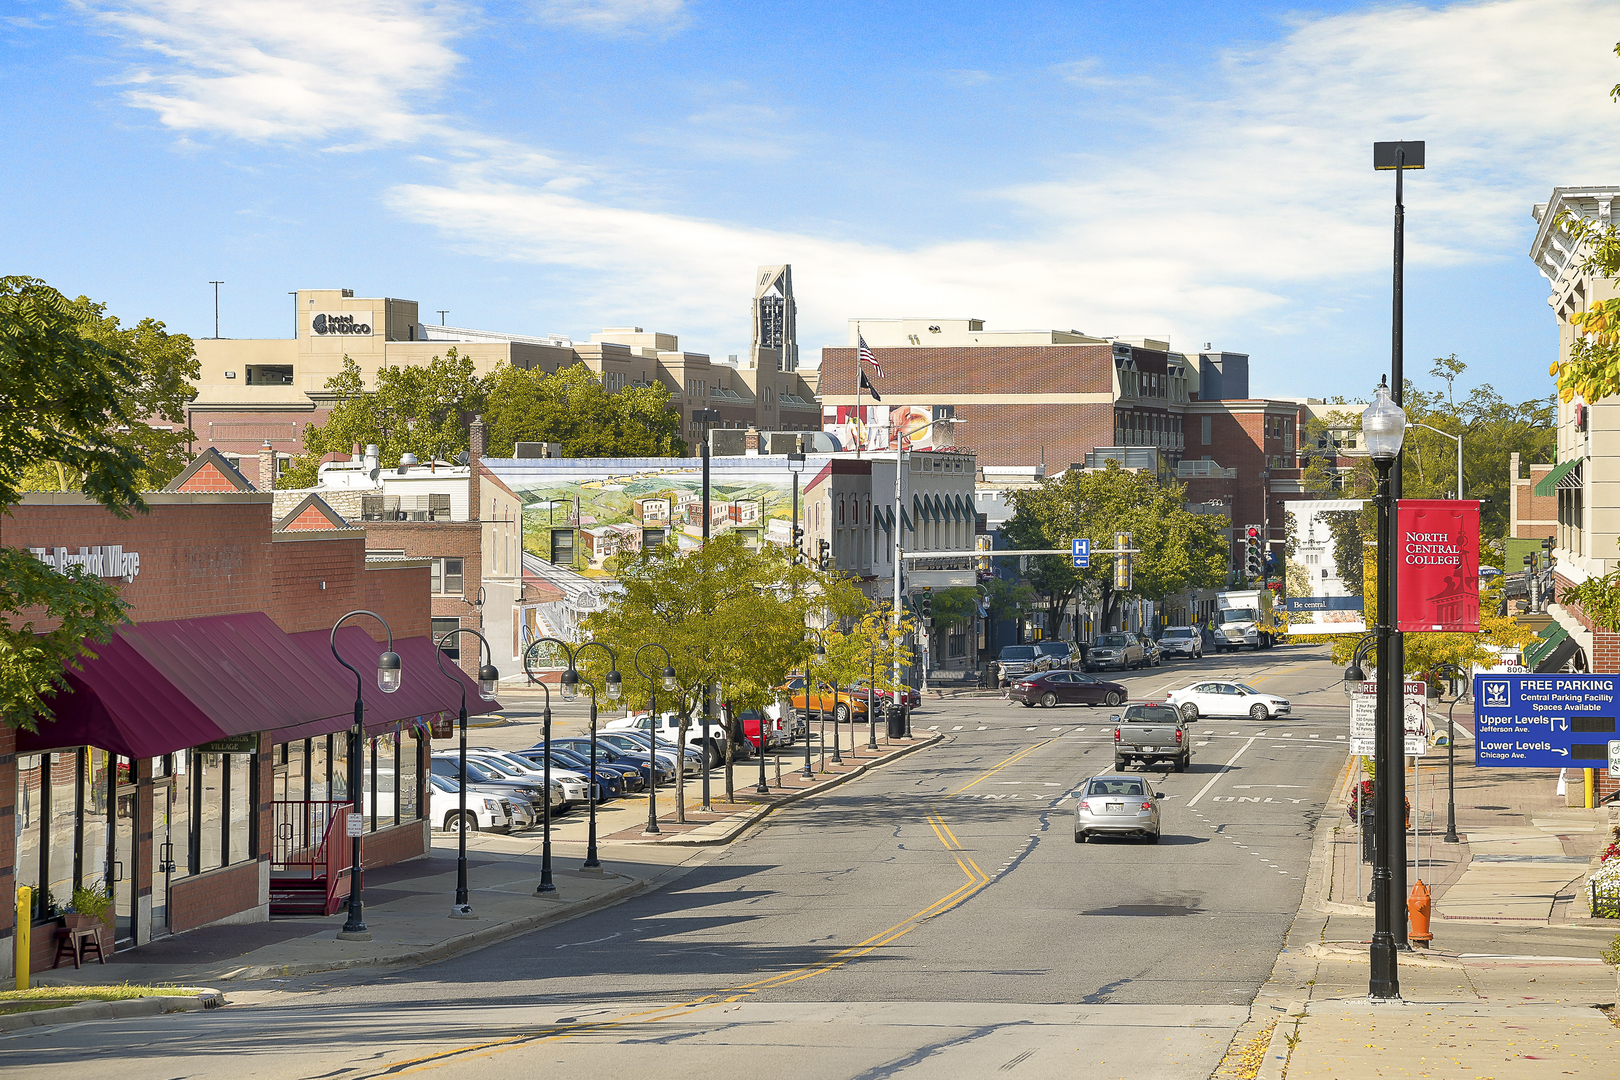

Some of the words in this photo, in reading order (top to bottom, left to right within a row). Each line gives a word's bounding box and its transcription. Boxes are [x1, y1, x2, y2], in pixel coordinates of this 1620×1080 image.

[328, 314, 353, 324] hotel
[328, 323, 371, 334] INDIGO
[1405, 531, 1448, 542] NORTH
[1075, 541, 1086, 554] H
[1405, 543, 1460, 554] CENTRAL
[106, 545, 140, 584] Village
[1405, 554, 1460, 565] COLLEGE
[1520, 680, 1553, 690] FREE
[1556, 680, 1613, 691] PARKING
[1520, 693, 1549, 701] Central
[1551, 693, 1582, 702] Parking
[1584, 693, 1613, 702] Facility
[1532, 703, 1562, 712] Spaces
[1564, 703, 1601, 711] Available
[1480, 715, 1512, 726] Upper
[1515, 715, 1549, 725] Levels
[1480, 741, 1513, 750] Lower
[1516, 741, 1551, 750] Levels
[1480, 751, 1509, 760] Chicago
[1212, 796, 1311, 804] ONLY
